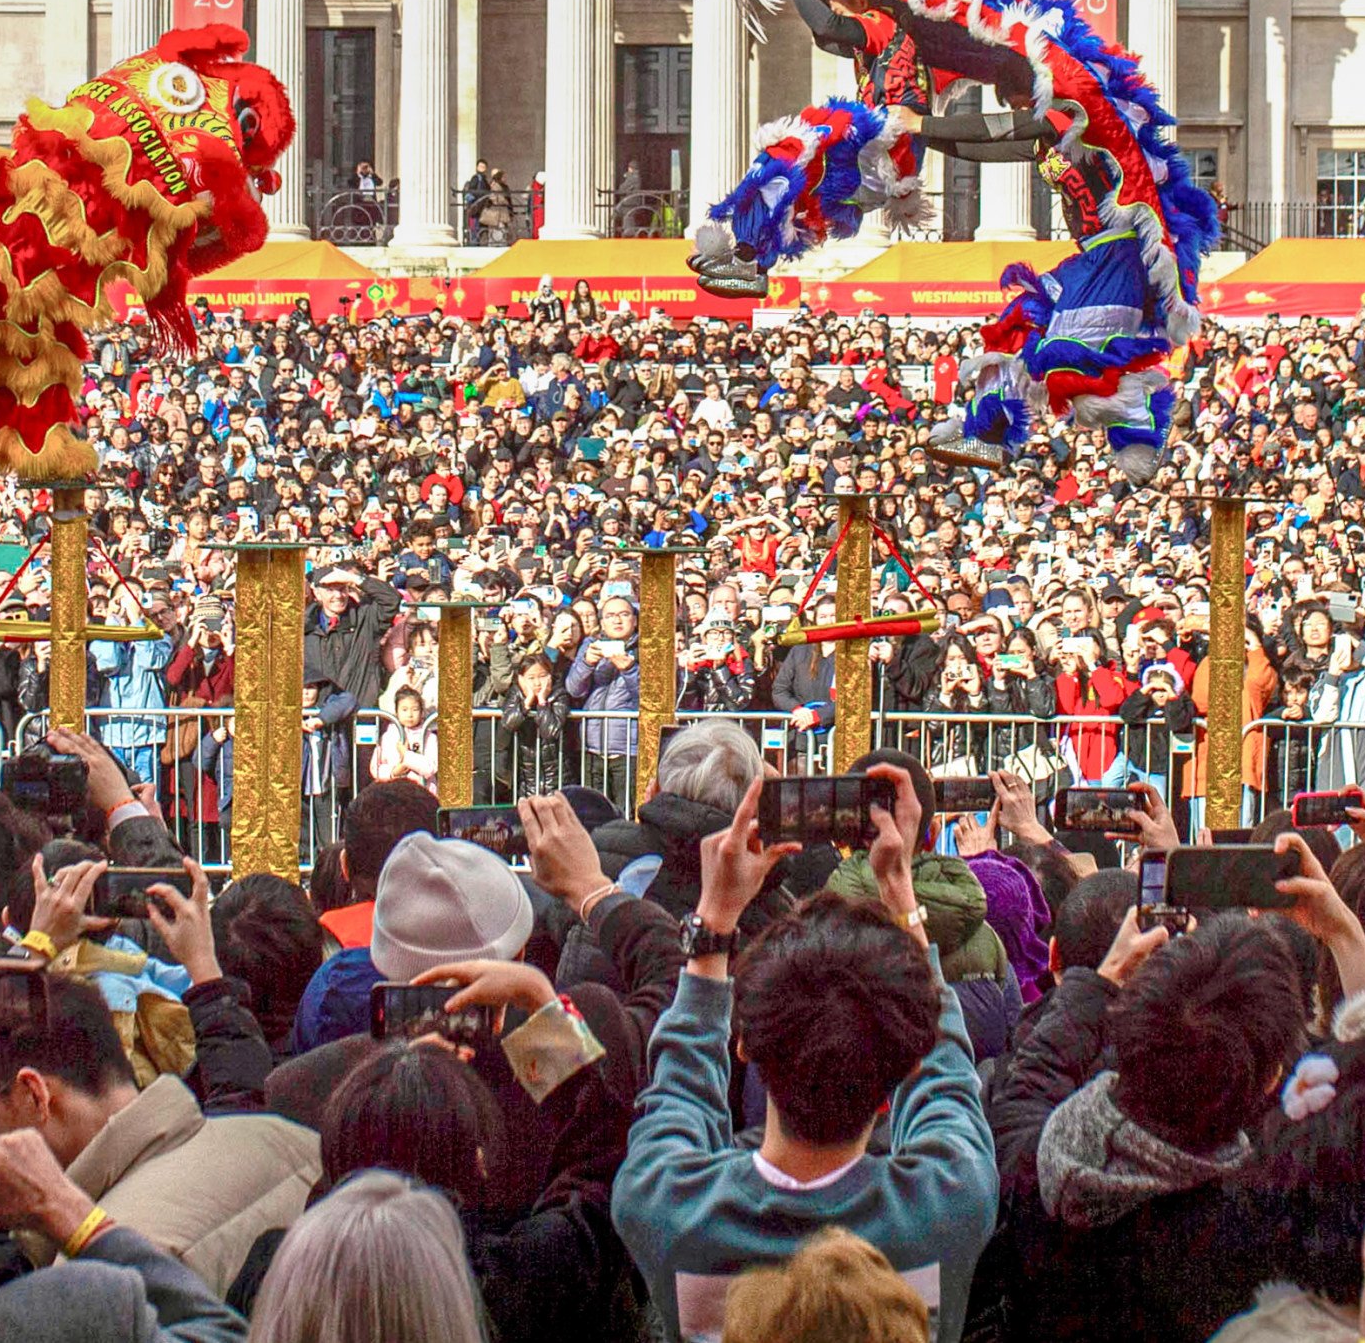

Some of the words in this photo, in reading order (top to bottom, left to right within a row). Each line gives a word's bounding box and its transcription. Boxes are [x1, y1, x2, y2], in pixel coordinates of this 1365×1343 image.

[108, 95, 188, 195] ASSOCIATION
[185, 293, 225, 306] CNA
[643, 289, 697, 303] LIMITED
[912, 291, 1004, 304] WESTMINSTER
